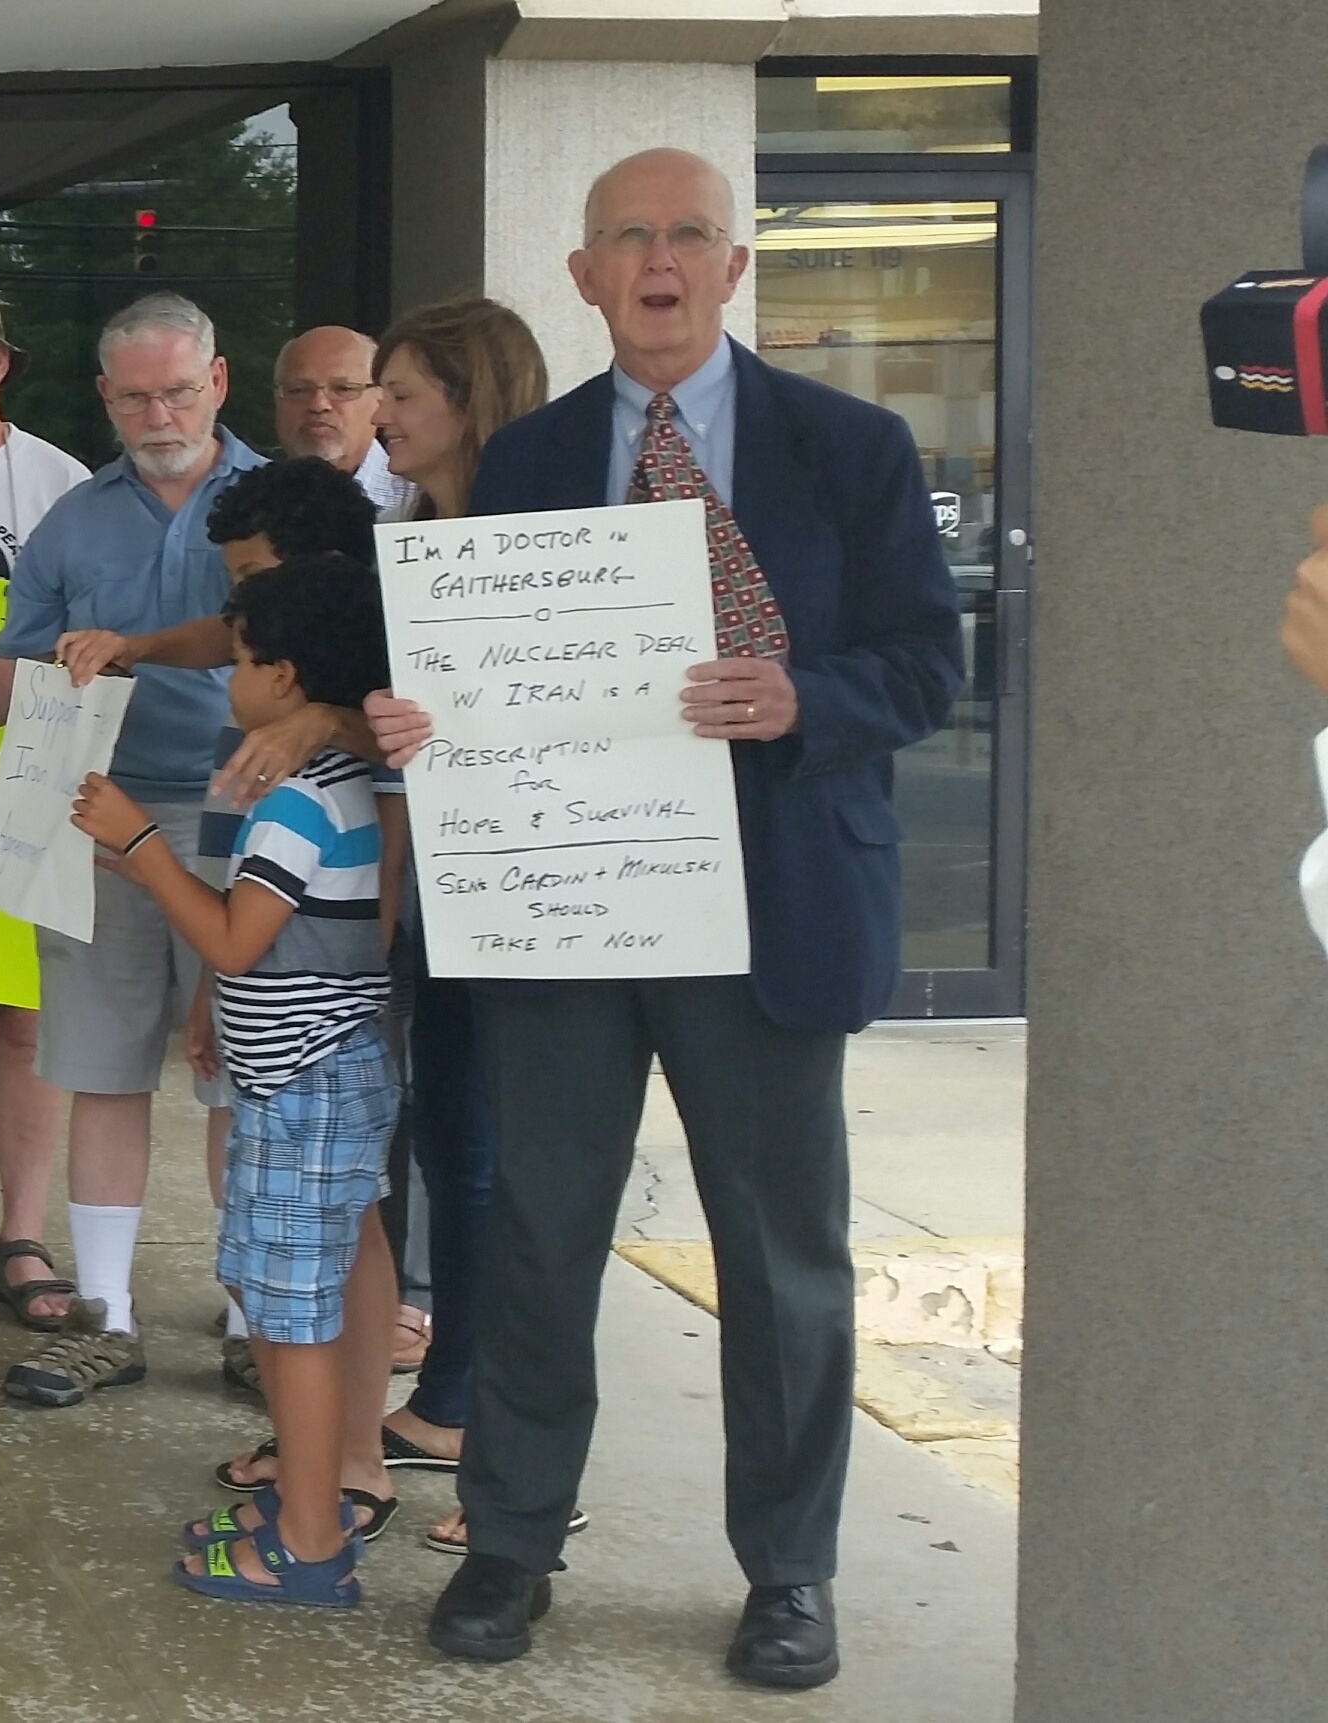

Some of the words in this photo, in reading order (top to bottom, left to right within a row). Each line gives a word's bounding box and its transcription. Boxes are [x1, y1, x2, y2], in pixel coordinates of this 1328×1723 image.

[457, 543, 476, 561] A
[494, 527, 592, 556] DOCTOR
[430, 565, 635, 600] GAITHERSBURG
[407, 645, 457, 674] THE
[479, 639, 618, 670] NUCLEAR
[634, 633, 699, 656] DEAL
[504, 680, 587, 709] IRAN
[635, 681, 651, 696] A
[439, 807, 504, 838] HOPE
[564, 798, 697, 827] SURVIVAL
[500, 865, 588, 894] CARDIN
[617, 854, 722, 882] MIKULSKI
[527, 901, 610, 919] SHOULD
[470, 932, 536, 953] TAKE
[556, 932, 585, 951] IT
[603, 930, 664, 950] NOW
